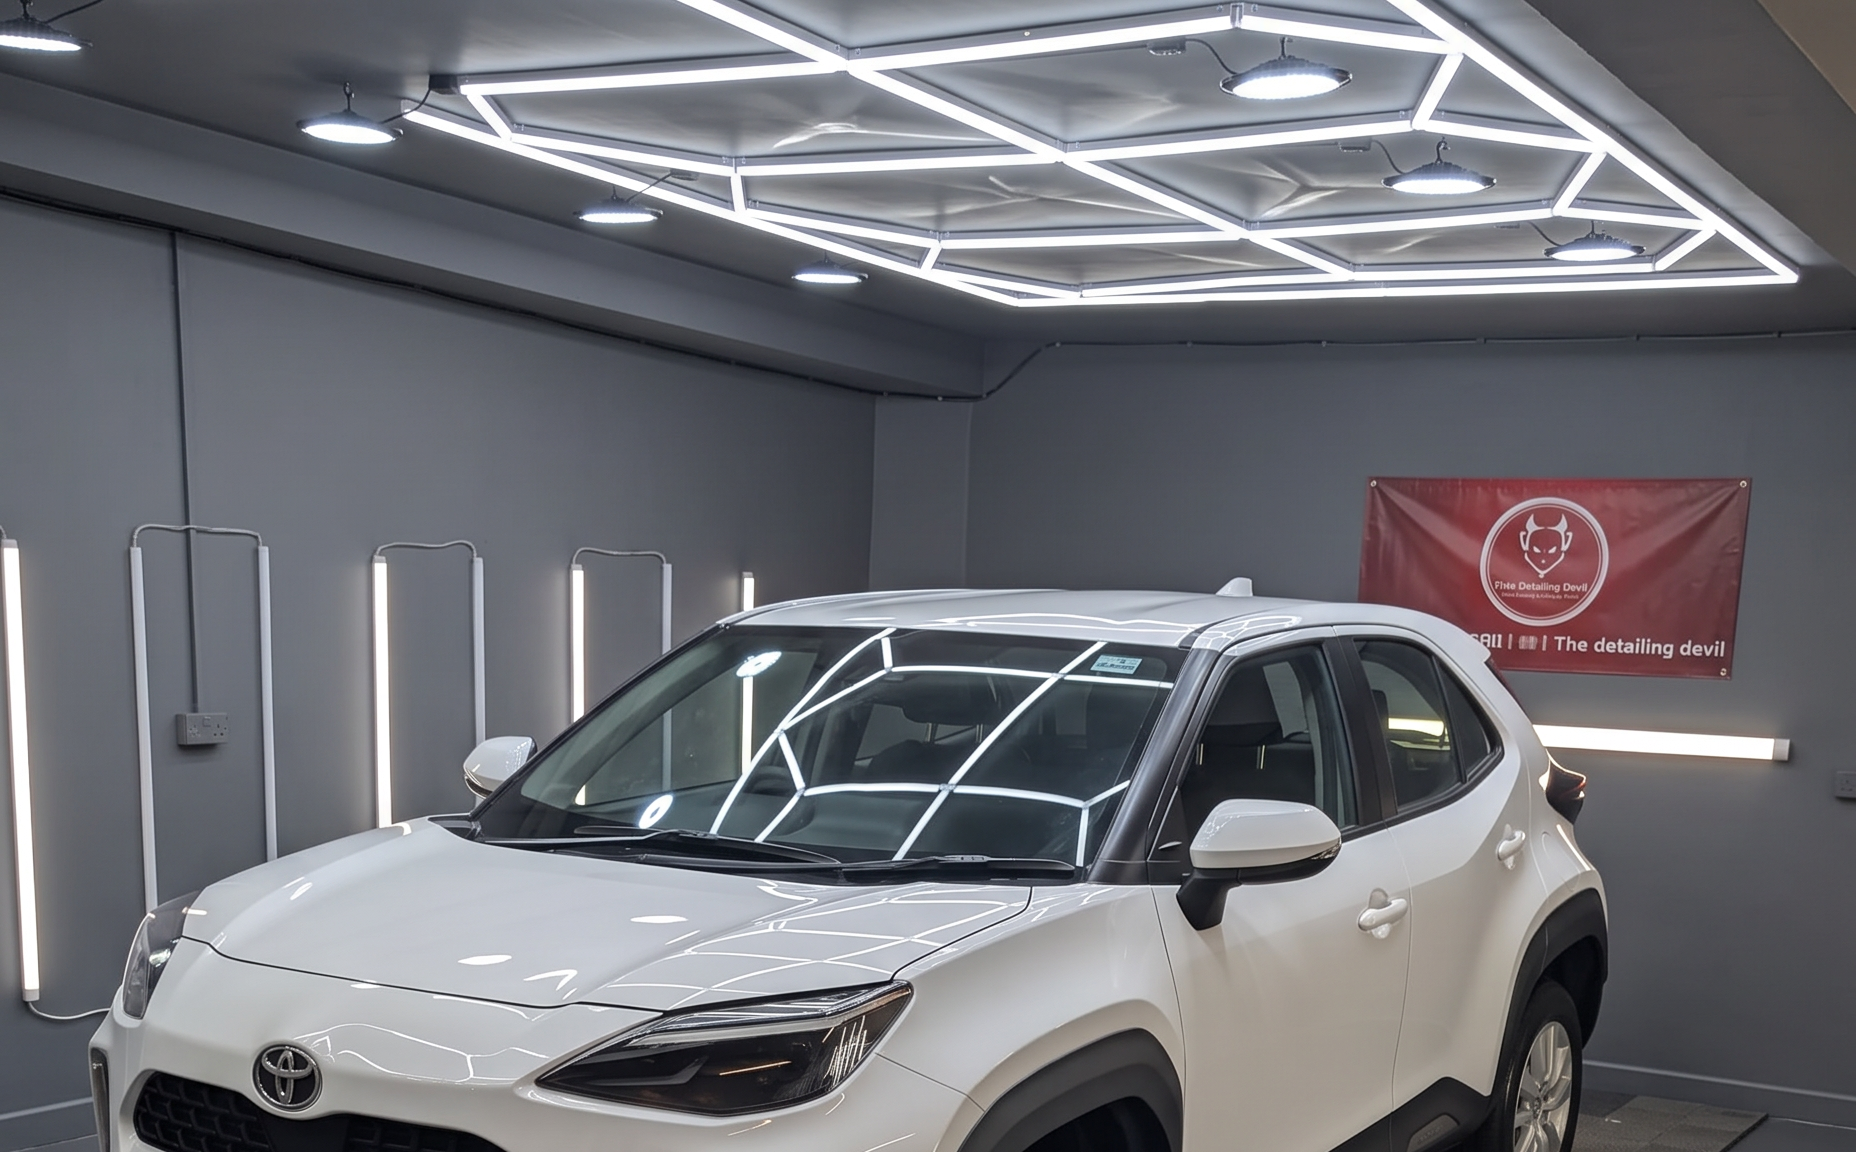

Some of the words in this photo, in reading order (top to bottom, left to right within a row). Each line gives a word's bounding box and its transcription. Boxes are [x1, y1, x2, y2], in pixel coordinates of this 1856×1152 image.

[1518, 581, 1561, 593] Detailing
[1554, 636, 1588, 652] The
[1594, 638, 1674, 659] detailing
[1679, 640, 1725, 657] devil
